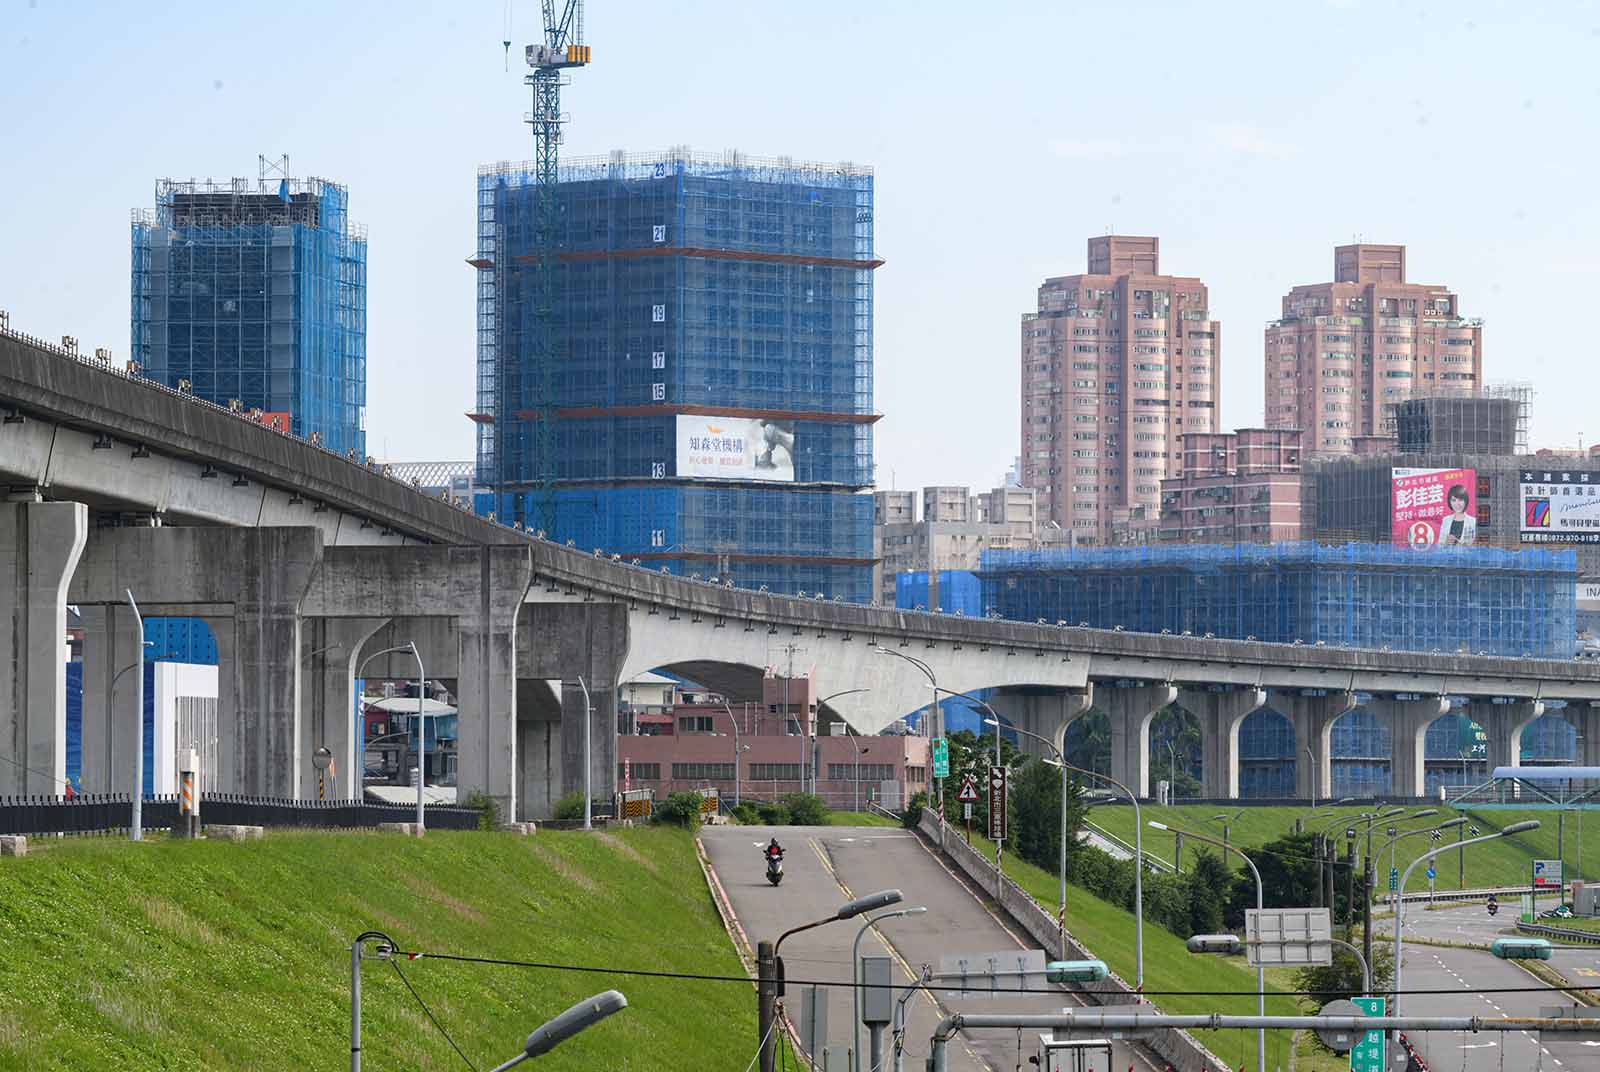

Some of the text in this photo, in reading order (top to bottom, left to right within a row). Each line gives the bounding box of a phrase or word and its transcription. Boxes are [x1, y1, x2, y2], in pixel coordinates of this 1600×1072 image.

[655, 163, 665, 177] 23
[654, 227, 664, 240] 21
[654, 306, 664, 320] 19
[653, 353, 664, 367] 17
[653, 385, 664, 398] 15
[689, 437, 743, 453] 知森堂機構
[653, 464, 665, 478] 13
[1396, 484, 1444, 510] 彭佳芸
[652, 530, 665, 546] 11
[1414, 523, 1428, 546] 8
[1371, 1002, 1377, 1012] 8
